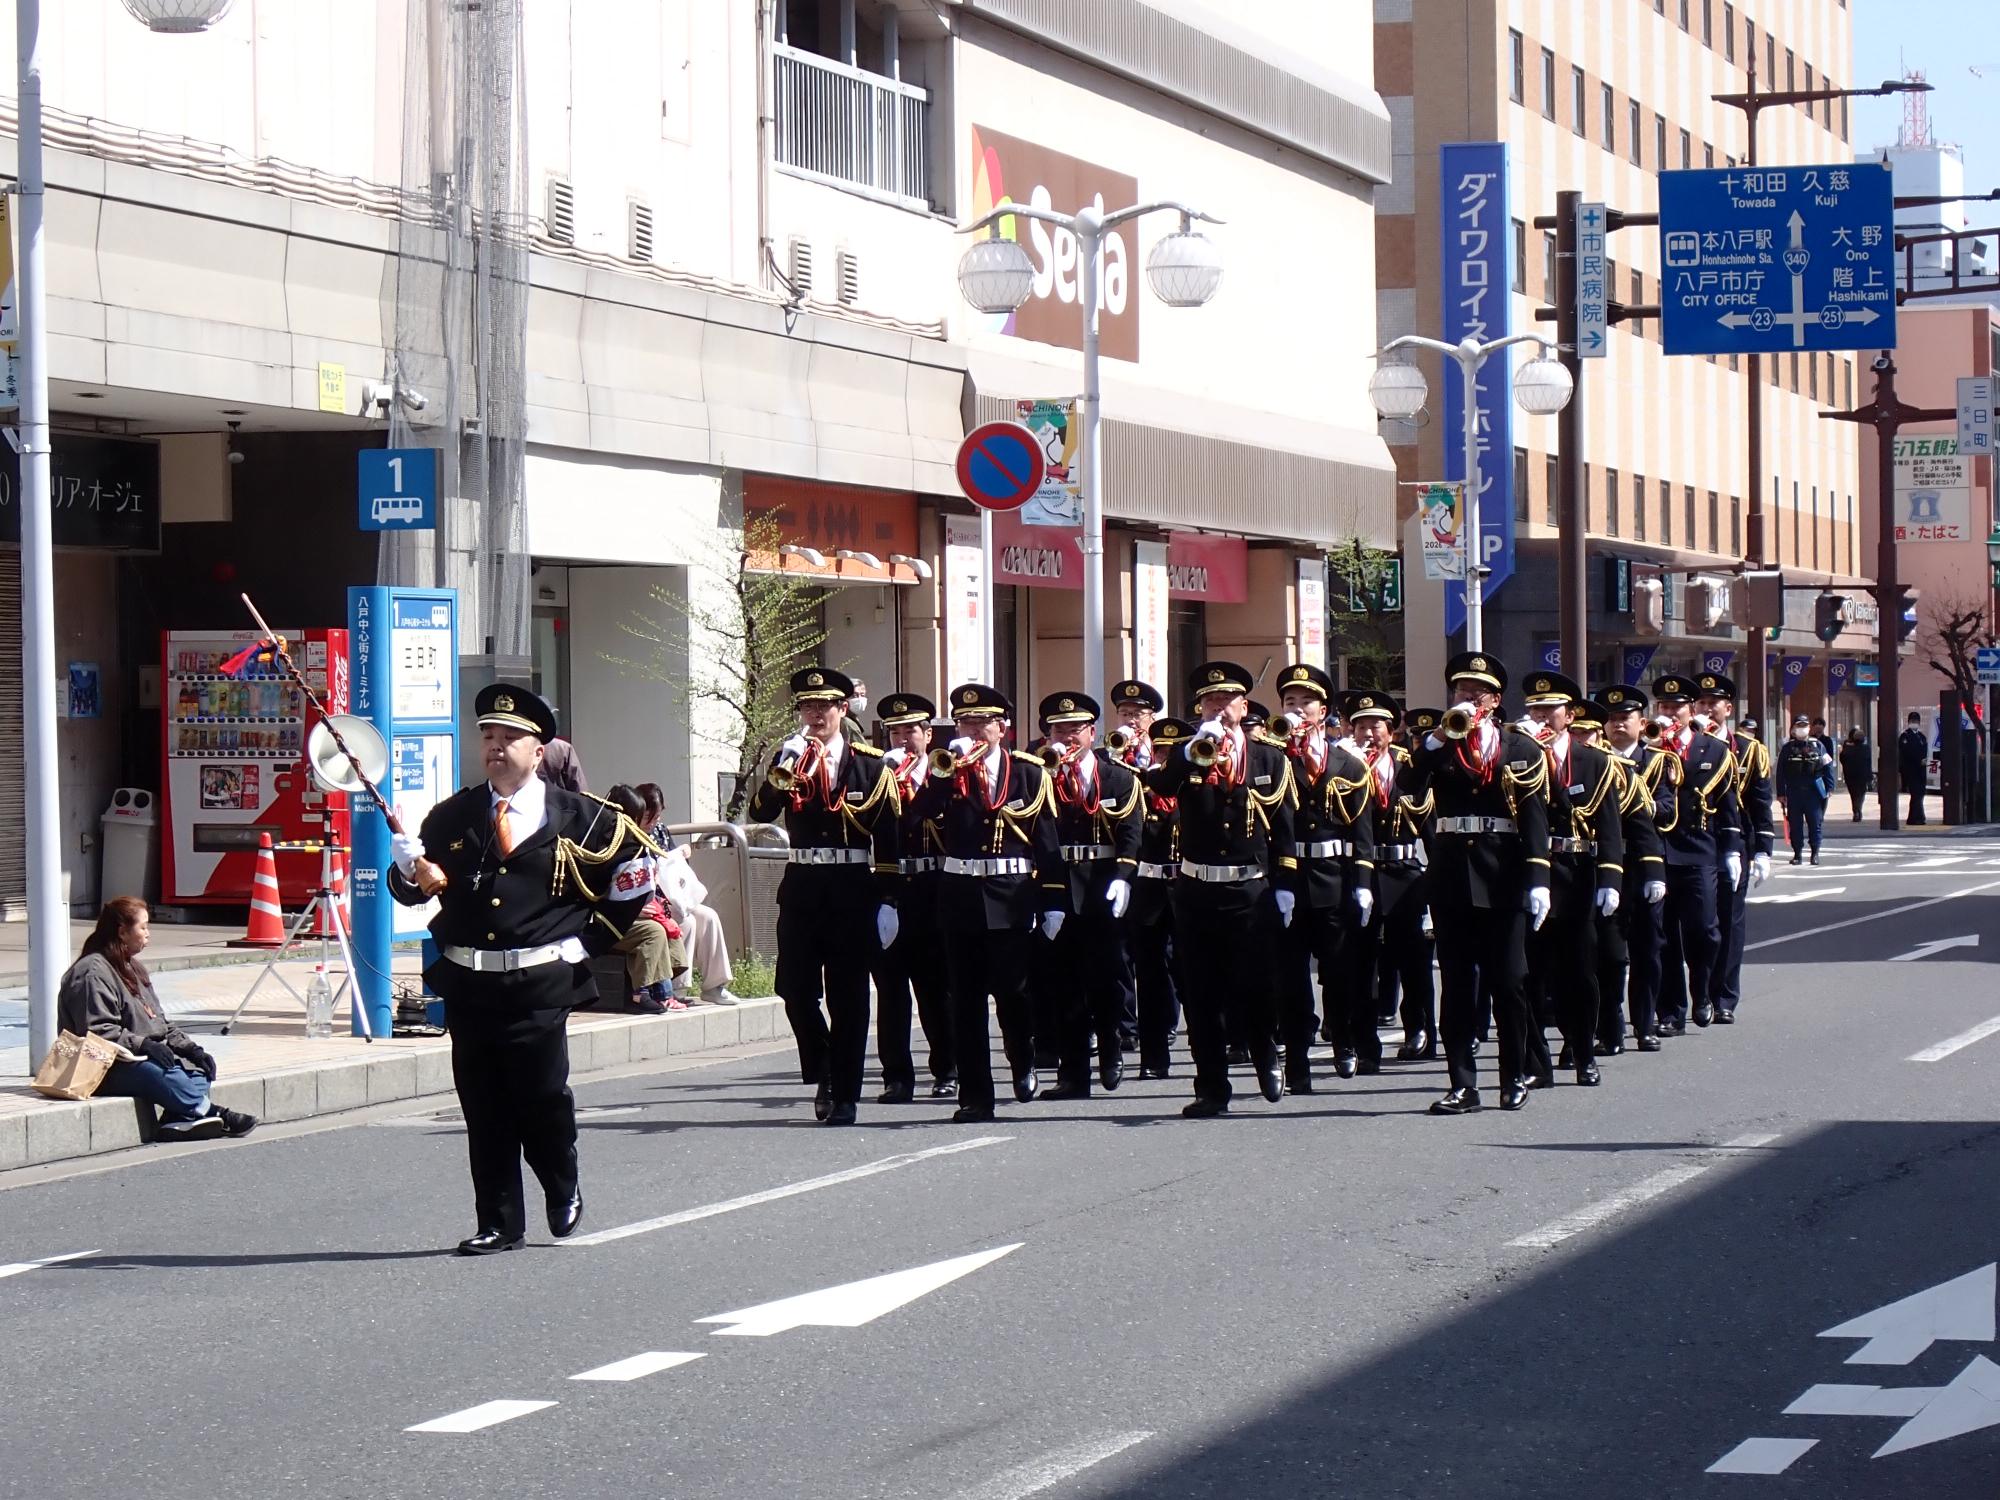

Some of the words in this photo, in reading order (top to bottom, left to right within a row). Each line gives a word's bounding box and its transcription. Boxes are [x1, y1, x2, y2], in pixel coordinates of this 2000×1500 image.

[1719, 173, 1786, 195] 十和田
[1802, 171, 1850, 192] 久慈
[1732, 197, 1776, 208] Towada
[1815, 195, 1838, 207] Kuji
[1702, 229, 1773, 251] 本八戸駅
[1832, 225, 1883, 247] 大野
[1702, 252, 1756, 265] Honhachinohe
[1785, 253, 1808, 266] 340
[1845, 250, 1870, 261] Ono
[1581, 232, 1602, 323] 市民病院
[1675, 270, 1765, 292] 八戸市庁
[1833, 266, 1885, 288] 階上
[1682, 295, 1709, 307] CITY
[1715, 293, 1758, 305] OFFICE
[1828, 290, 1889, 302] Hashikami
[1754, 313, 1771, 326] 23
[1823, 311, 1842, 323] 251
[1973, 385, 1988, 448] 三日町
[388, 458, 403, 492] 1
[393, 600, 399, 628] 1
[358, 596, 370, 710] 八戸中心街ターミナル
[404, 646, 437, 670] 三日町
[354, 805, 375, 813] Machi
